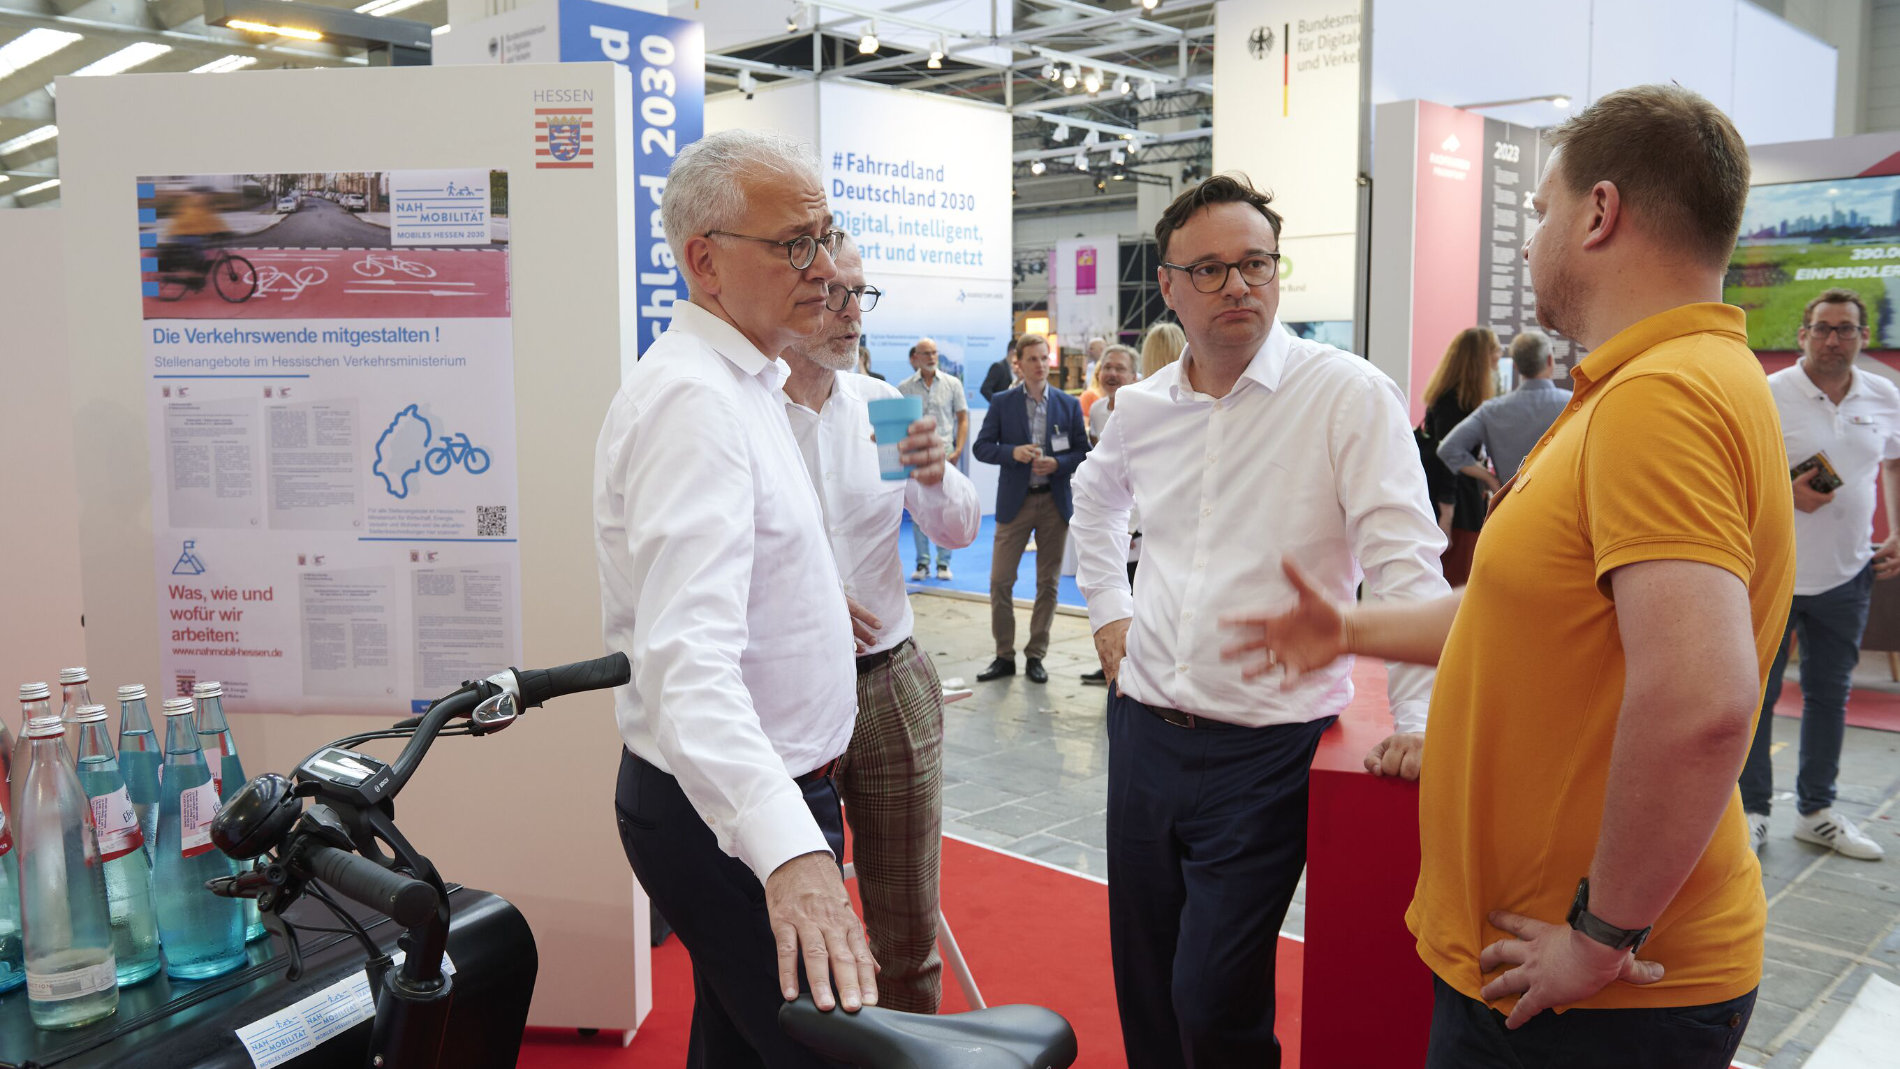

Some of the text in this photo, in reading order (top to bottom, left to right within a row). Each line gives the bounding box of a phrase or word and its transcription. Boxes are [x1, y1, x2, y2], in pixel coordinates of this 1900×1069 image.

[1298, 38, 1314, 52] für
[1297, 56, 1320, 72] und
[533, 89, 594, 103] HESSEN
[640, 34, 677, 158] 2030
[1493, 141, 1520, 163] 2023
[833, 152, 944, 183] #Fahrradland
[833, 179, 975, 211] Deutschland 2030
[396, 202, 424, 213] NAH
[420, 210, 484, 223] MOBILITÄT
[396, 230, 485, 240] MOBILES HESSEN 2030
[833, 210, 983, 244] Digital, intelligent,
[858, 243, 983, 266] art und vernetzt
[1850, 247, 1900, 260] 390.0
[152, 327, 441, 347] Die Verkehrswende mitgestalten !
[154, 355, 467, 371] Stellenangebote im Hessischen Verkehrsministerium
[168, 585, 273, 603] Was, wie und
[169, 605, 243, 623] wofür wir
[171, 627, 240, 643] arbeiten:
[172, 647, 283, 658] www.nahmobil-hessen.de
[307, 1013, 324, 1026] NAH
[251, 1038, 271, 1051] NAH
[269, 1029, 307, 1052] MOBILITÄT
